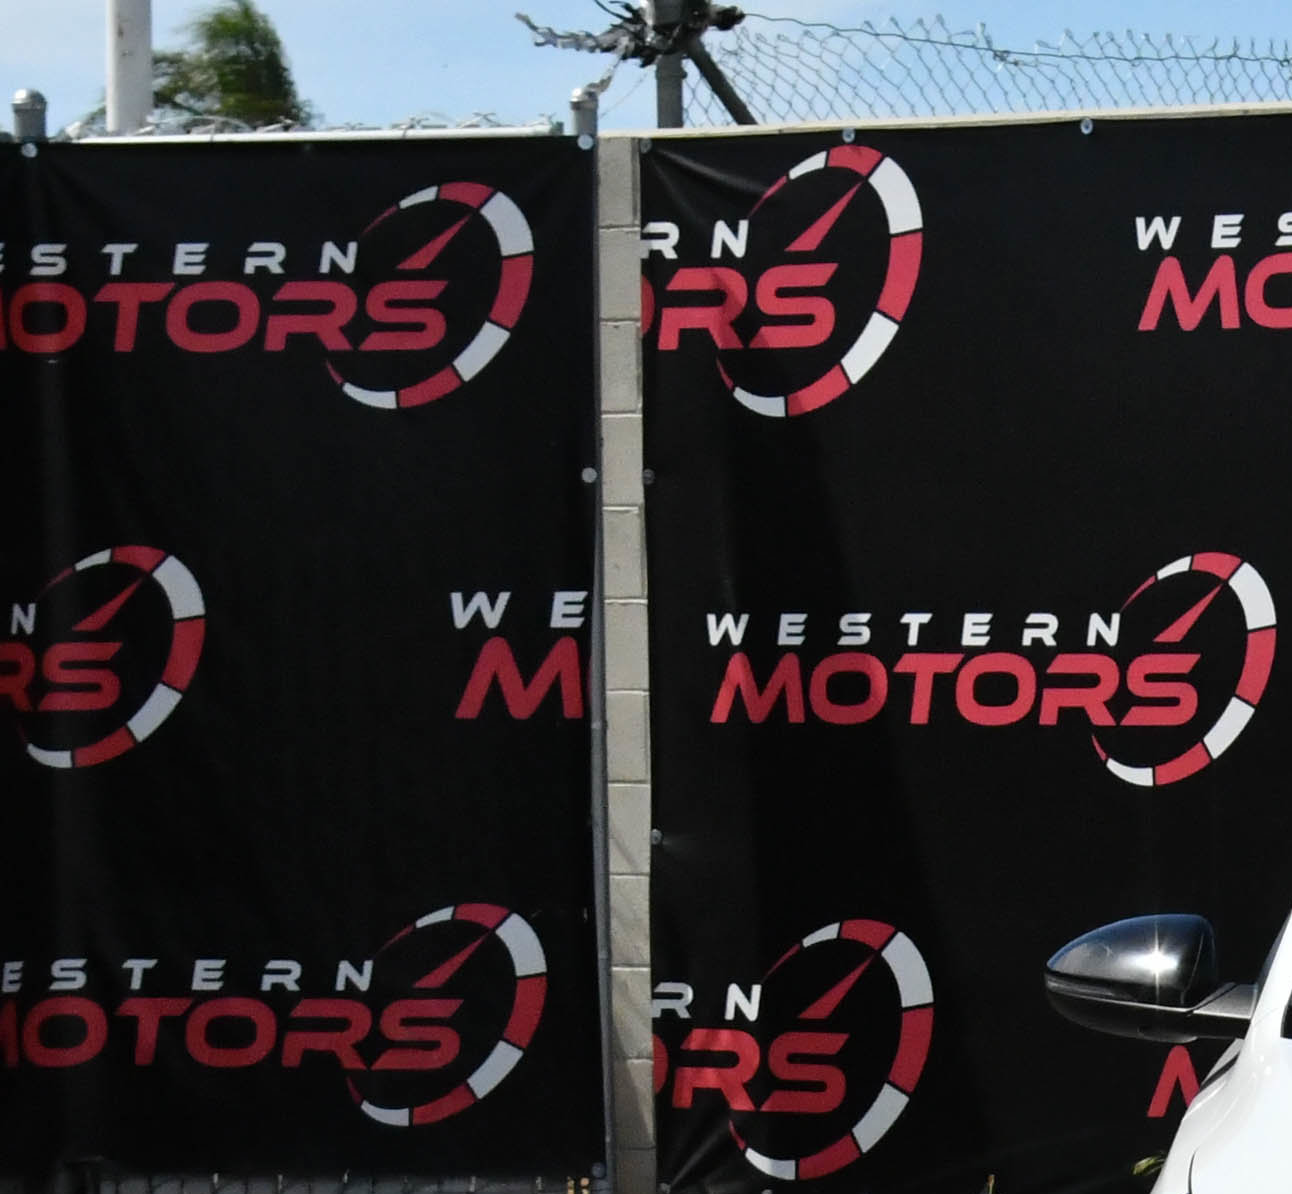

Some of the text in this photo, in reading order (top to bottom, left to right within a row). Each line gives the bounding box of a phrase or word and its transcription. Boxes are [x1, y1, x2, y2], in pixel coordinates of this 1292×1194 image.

[0, 241, 358, 276] STERN
[0, 279, 448, 353] OTORS
[641, 261, 840, 351] RS
[11, 602, 37, 635] N
[450, 591, 589, 629] WE
[706, 612, 1121, 647] WESTERN
[454, 635, 592, 720] M
[710, 651, 1201, 727] MOTORS
[2, 958, 374, 992] ESTERN
[0, 996, 463, 1070] OTORS
[652, 1027, 851, 1113] RS
